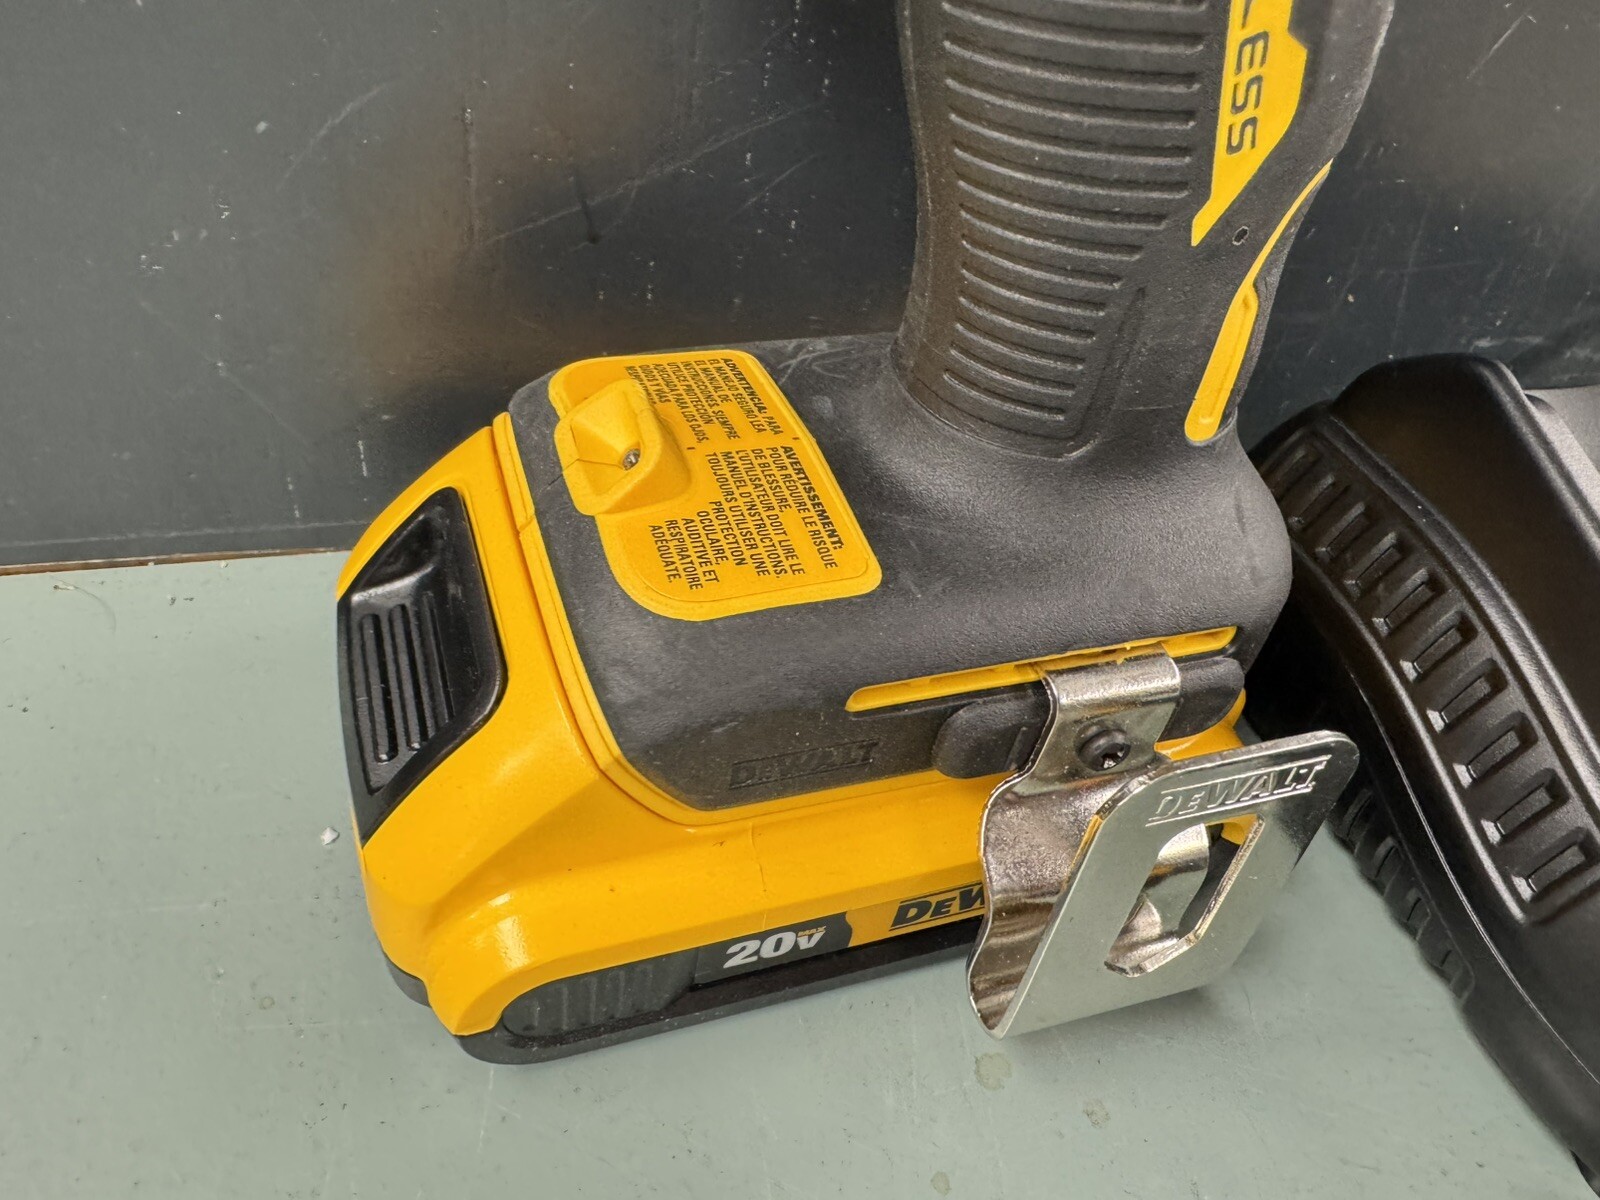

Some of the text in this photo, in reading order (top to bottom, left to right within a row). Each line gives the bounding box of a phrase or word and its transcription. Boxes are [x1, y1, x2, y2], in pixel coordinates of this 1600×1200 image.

[681, 411, 698, 423] LOS
[700, 367, 725, 393] MANUAL
[717, 394, 733, 403] DE
[713, 366, 740, 392] MANEJO
[732, 393, 759, 419] SEGURO
[749, 420, 767, 433] LEA
[721, 358, 784, 435] ADVERTENCIA: PARA
[712, 410, 740, 440] SIEMPRE
[720, 451, 748, 490] MANUEL
[751, 448, 792, 512] DE BLESSURE,
[780, 445, 844, 550] AVERTISSEMENT:
[696, 510, 729, 565] OCULAIRE,
[705, 452, 771, 576] TOUJOURS UTILISER UNE
[709, 501, 748, 566] PROTECTION
[735, 449, 805, 576] L'UTILISATEUR DOIT LIRE LE
[766, 447, 838, 569] POUR RÉDUIRE LE RISQUE
[664, 519, 704, 590] RESPIRATOIRE
[681, 518, 720, 582] AUDITIVE ET
[1147, 760, 1328, 822] DEWALT
[890, 884, 985, 927] DEW
